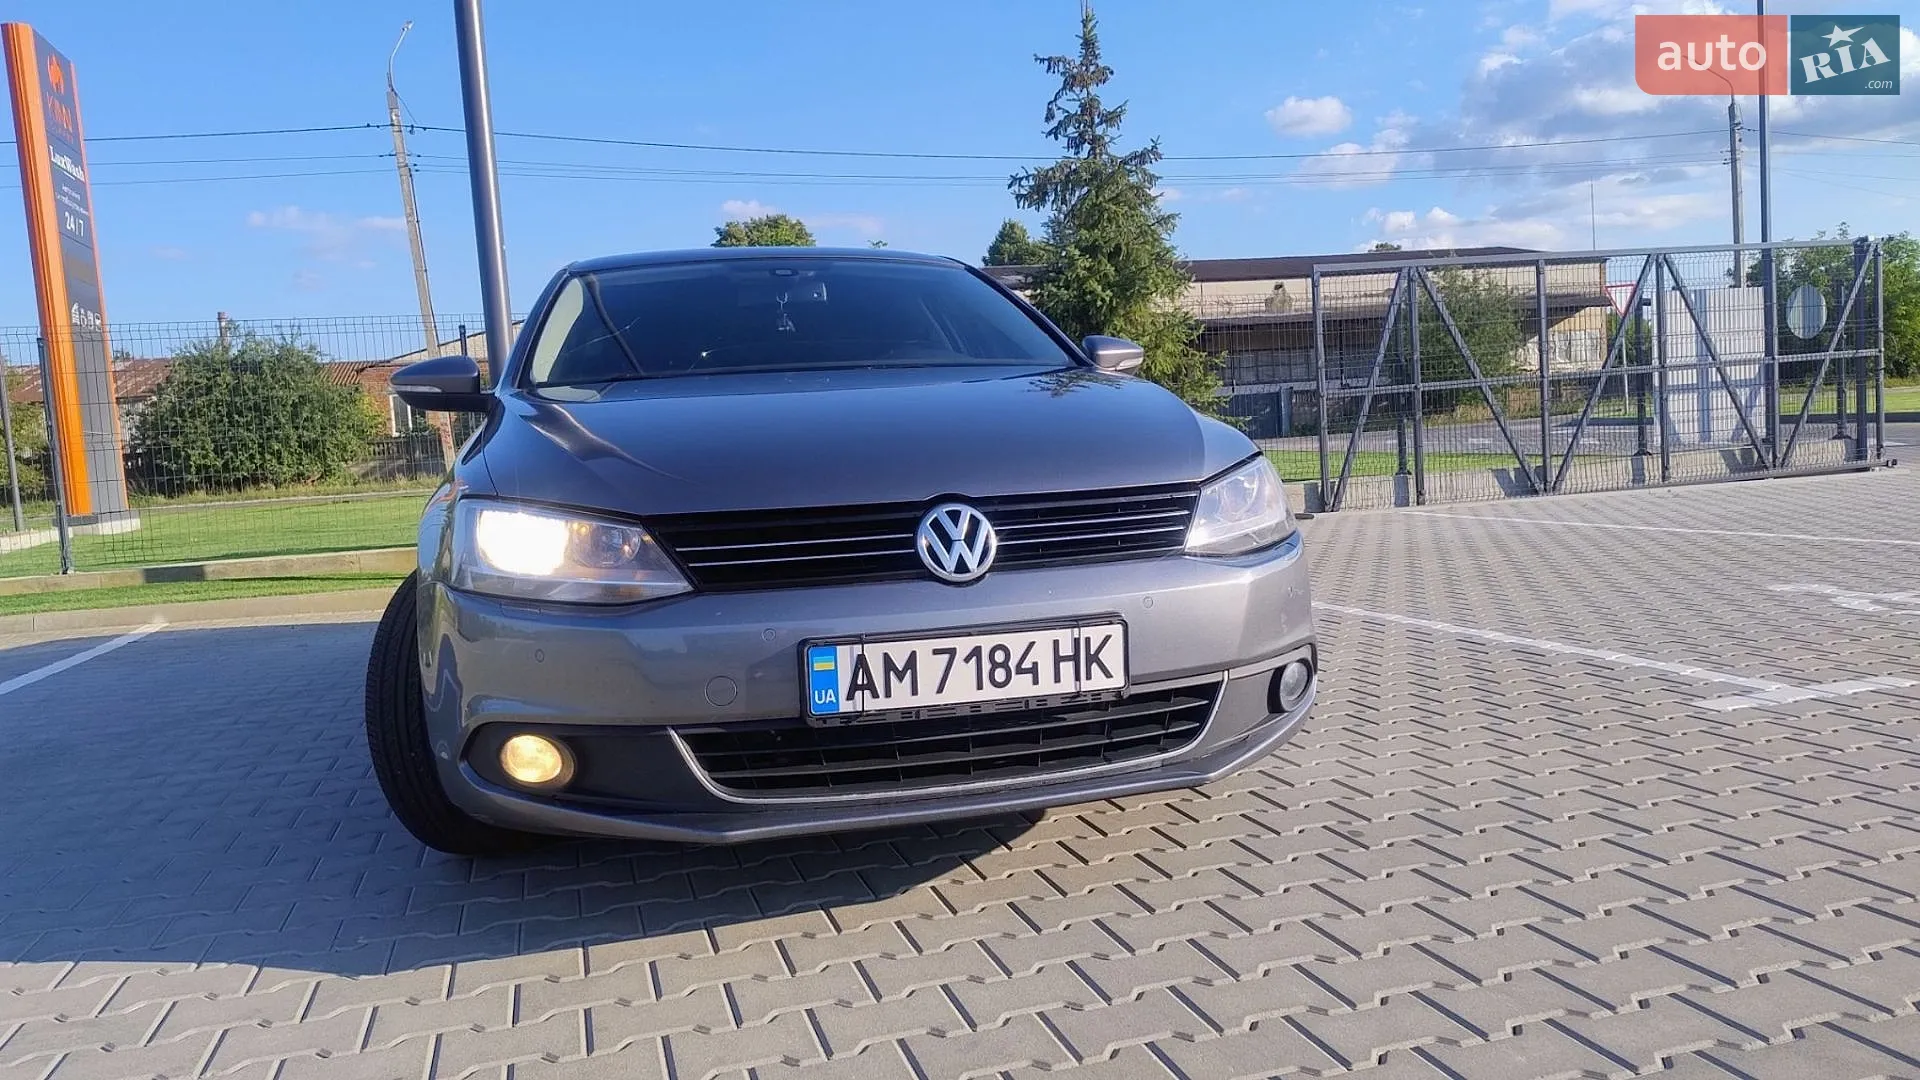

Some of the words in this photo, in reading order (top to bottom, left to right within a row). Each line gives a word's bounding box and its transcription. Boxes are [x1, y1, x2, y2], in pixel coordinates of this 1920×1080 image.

[846, 650, 919, 701] AM
[932, 640, 1040, 695] 7184
[1053, 634, 1114, 684] HK
[814, 688, 837, 704] UA
